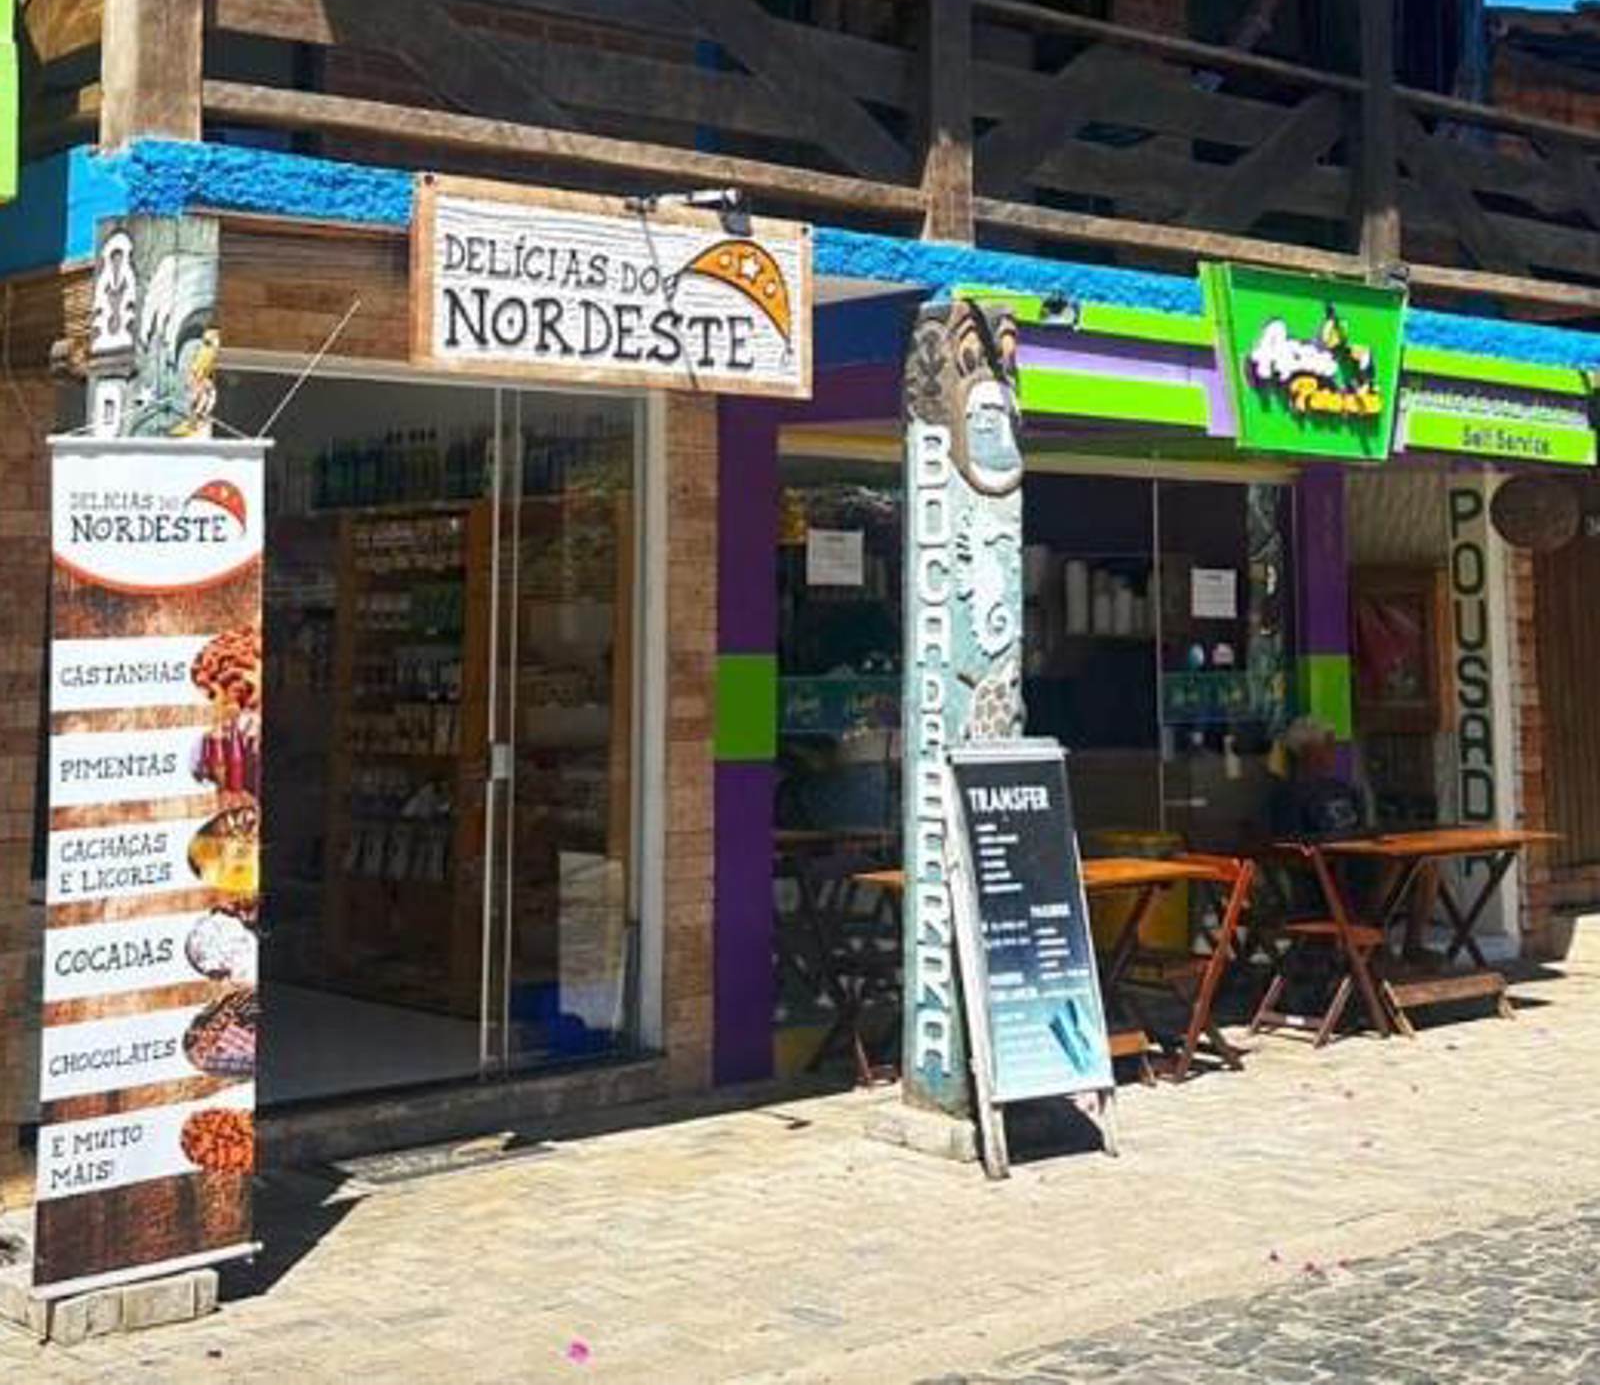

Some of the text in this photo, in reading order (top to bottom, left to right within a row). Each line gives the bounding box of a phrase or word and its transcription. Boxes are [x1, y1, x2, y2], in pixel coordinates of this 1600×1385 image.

[443, 233, 659, 295] DELÍCIAS DO
[443, 288, 755, 370] NORDESTE
[70, 513, 228, 544] NORDESTE
[59, 661, 187, 688] CASTANHAS
[1448, 487, 1494, 877] POUSAD
[60, 753, 178, 782] PIMENTAS
[967, 785, 1051, 813] TRANSFER
[59, 863, 174, 894] E LICORES
[54, 938, 174, 976] COCADAS
[48, 1039, 178, 1077] CHOCOLATES
[52, 1124, 144, 1159] E MUITO
